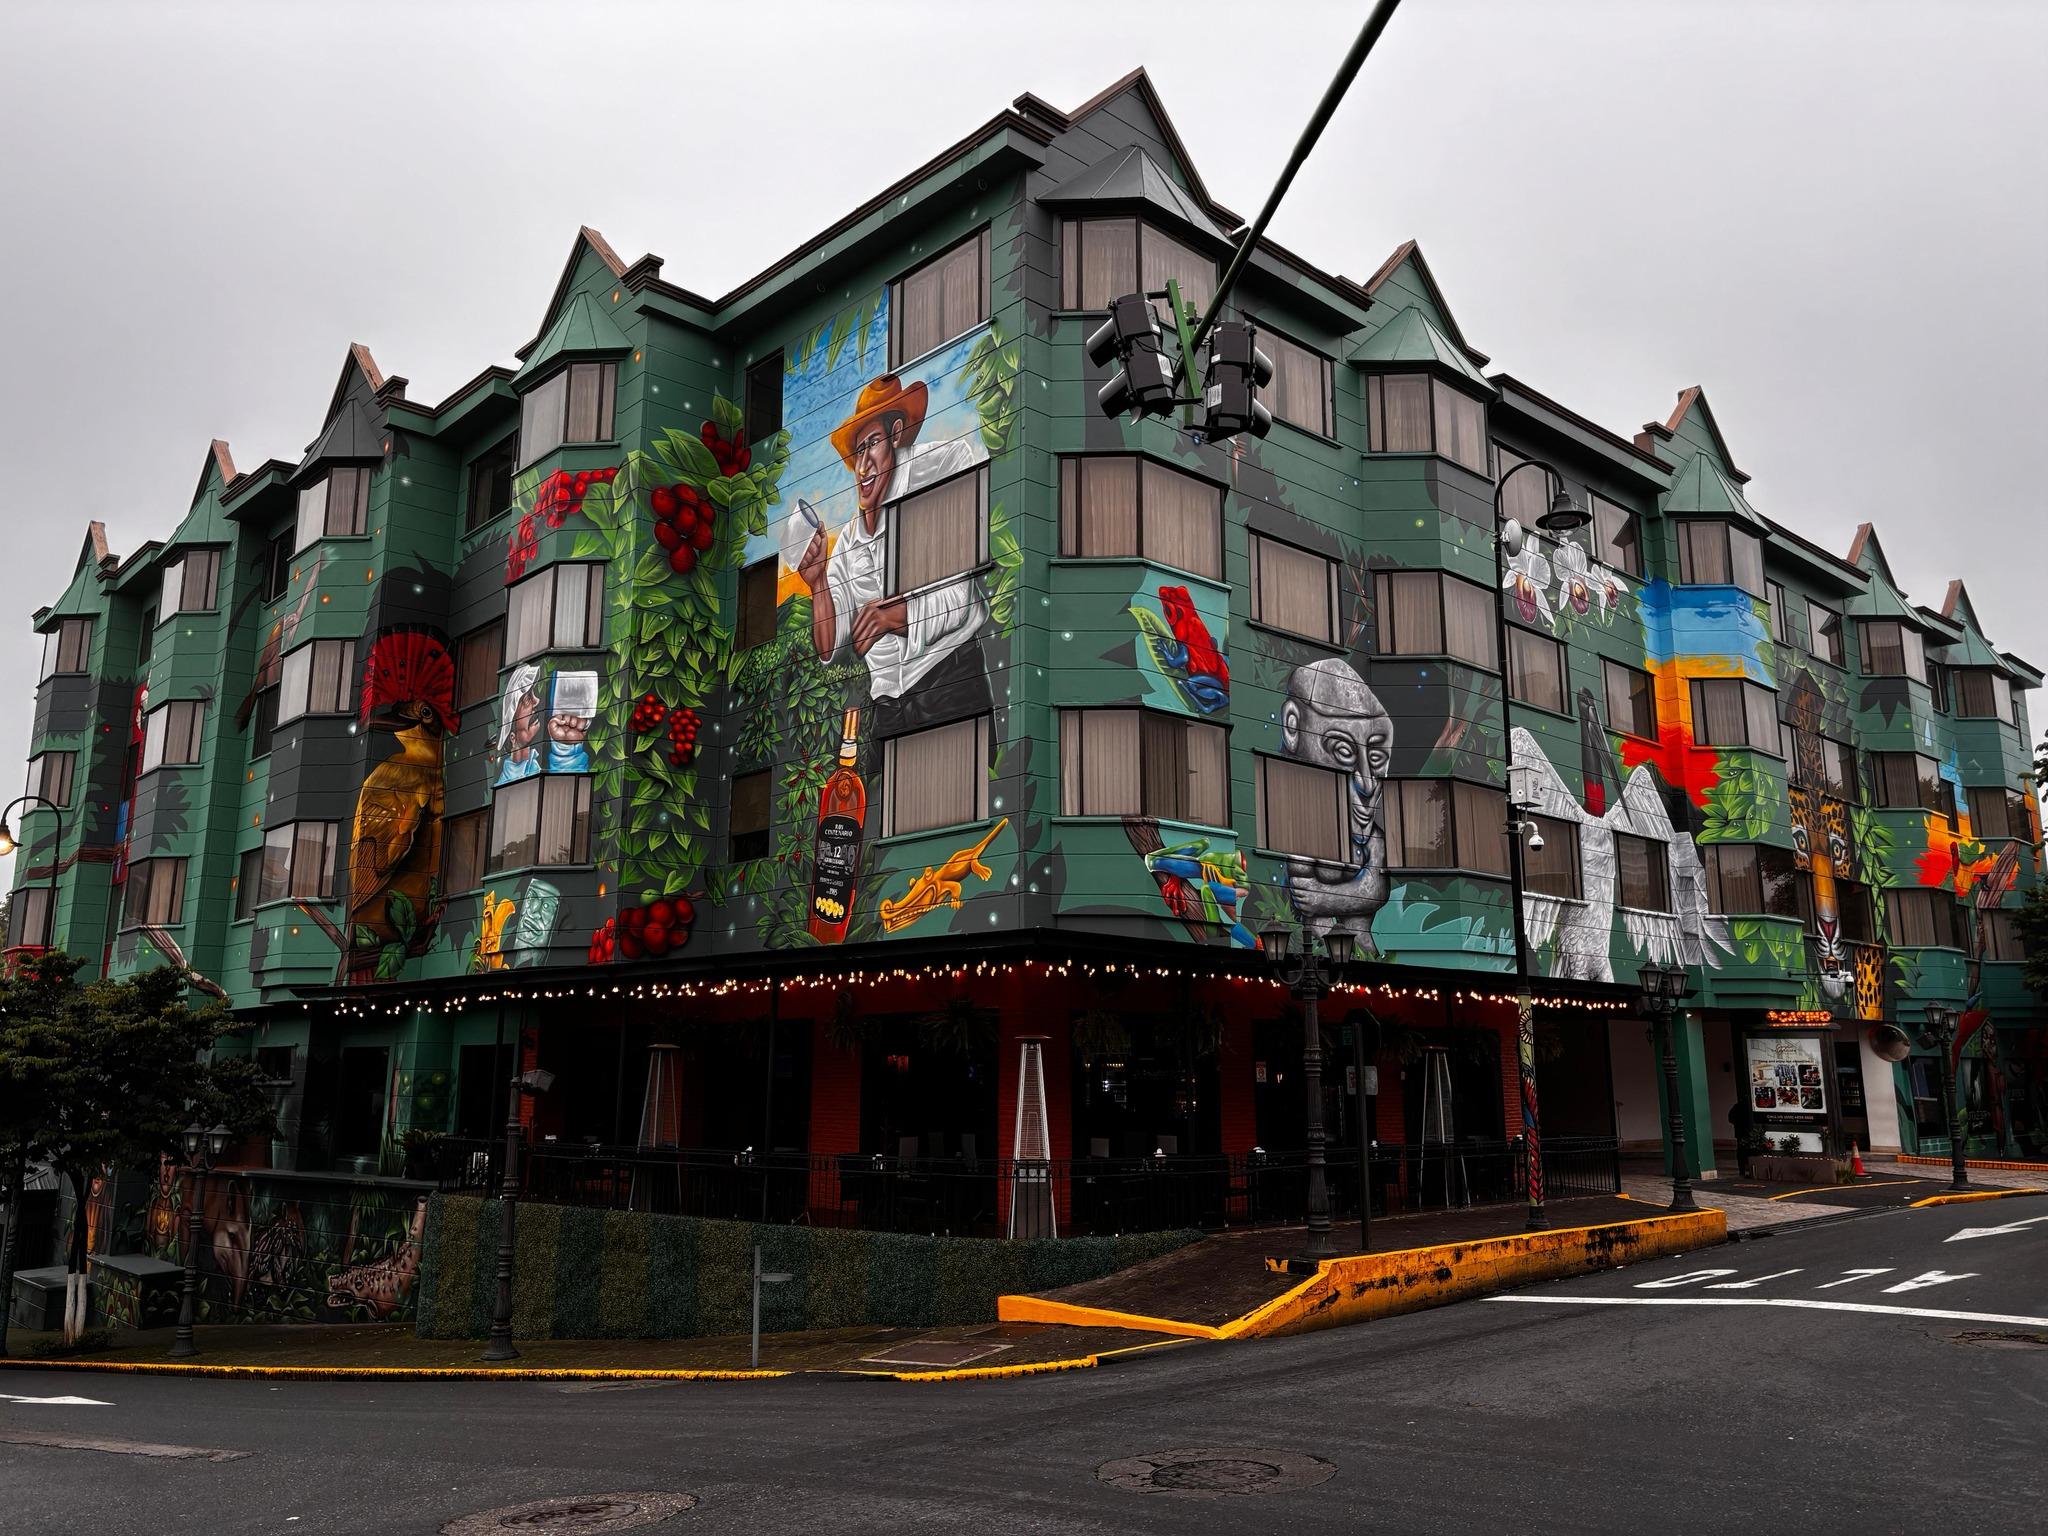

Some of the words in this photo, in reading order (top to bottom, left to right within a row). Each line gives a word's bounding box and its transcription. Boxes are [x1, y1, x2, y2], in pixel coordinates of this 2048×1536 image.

[824, 829, 853, 837] CENTENARIO
[834, 846, 841, 858] 12
[1779, 1011, 1831, 1023] CASINO
